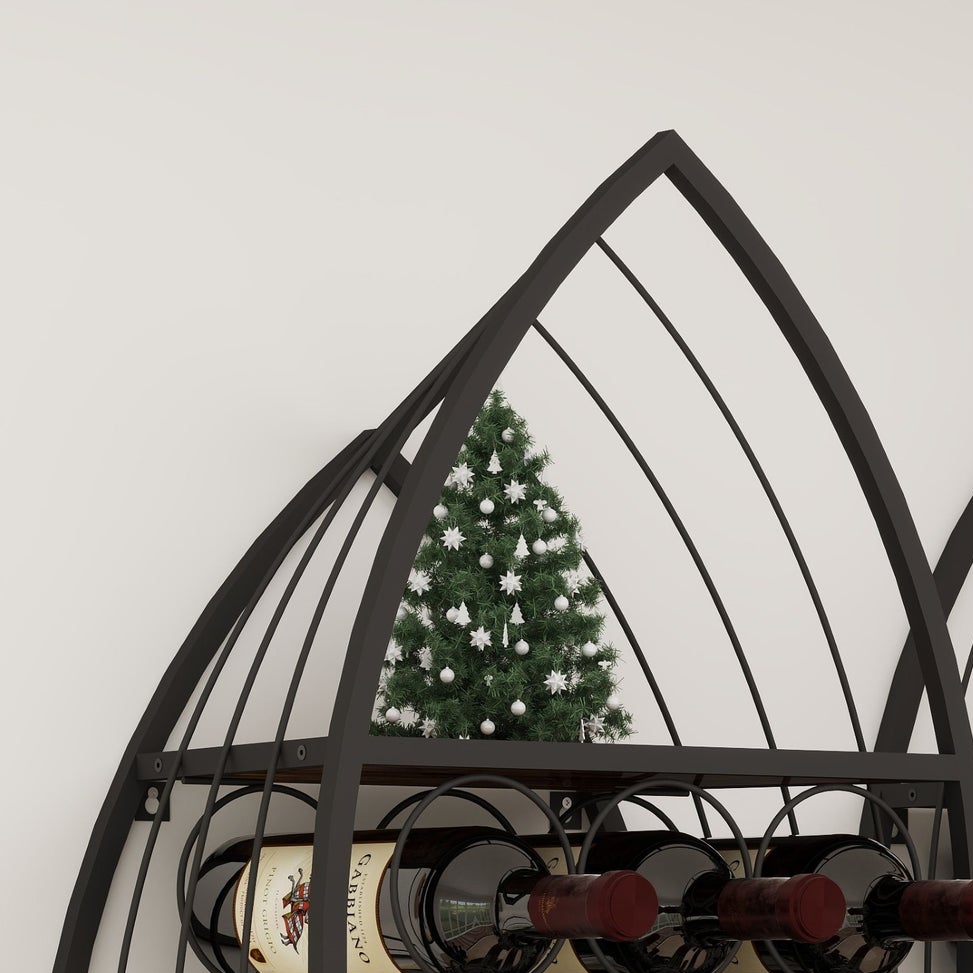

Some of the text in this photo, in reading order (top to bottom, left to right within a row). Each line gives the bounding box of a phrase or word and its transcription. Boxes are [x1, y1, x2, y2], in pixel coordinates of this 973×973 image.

[262, 866, 277, 955] PINOT GRIGIO
[346, 853, 372, 964] GABBIANO
